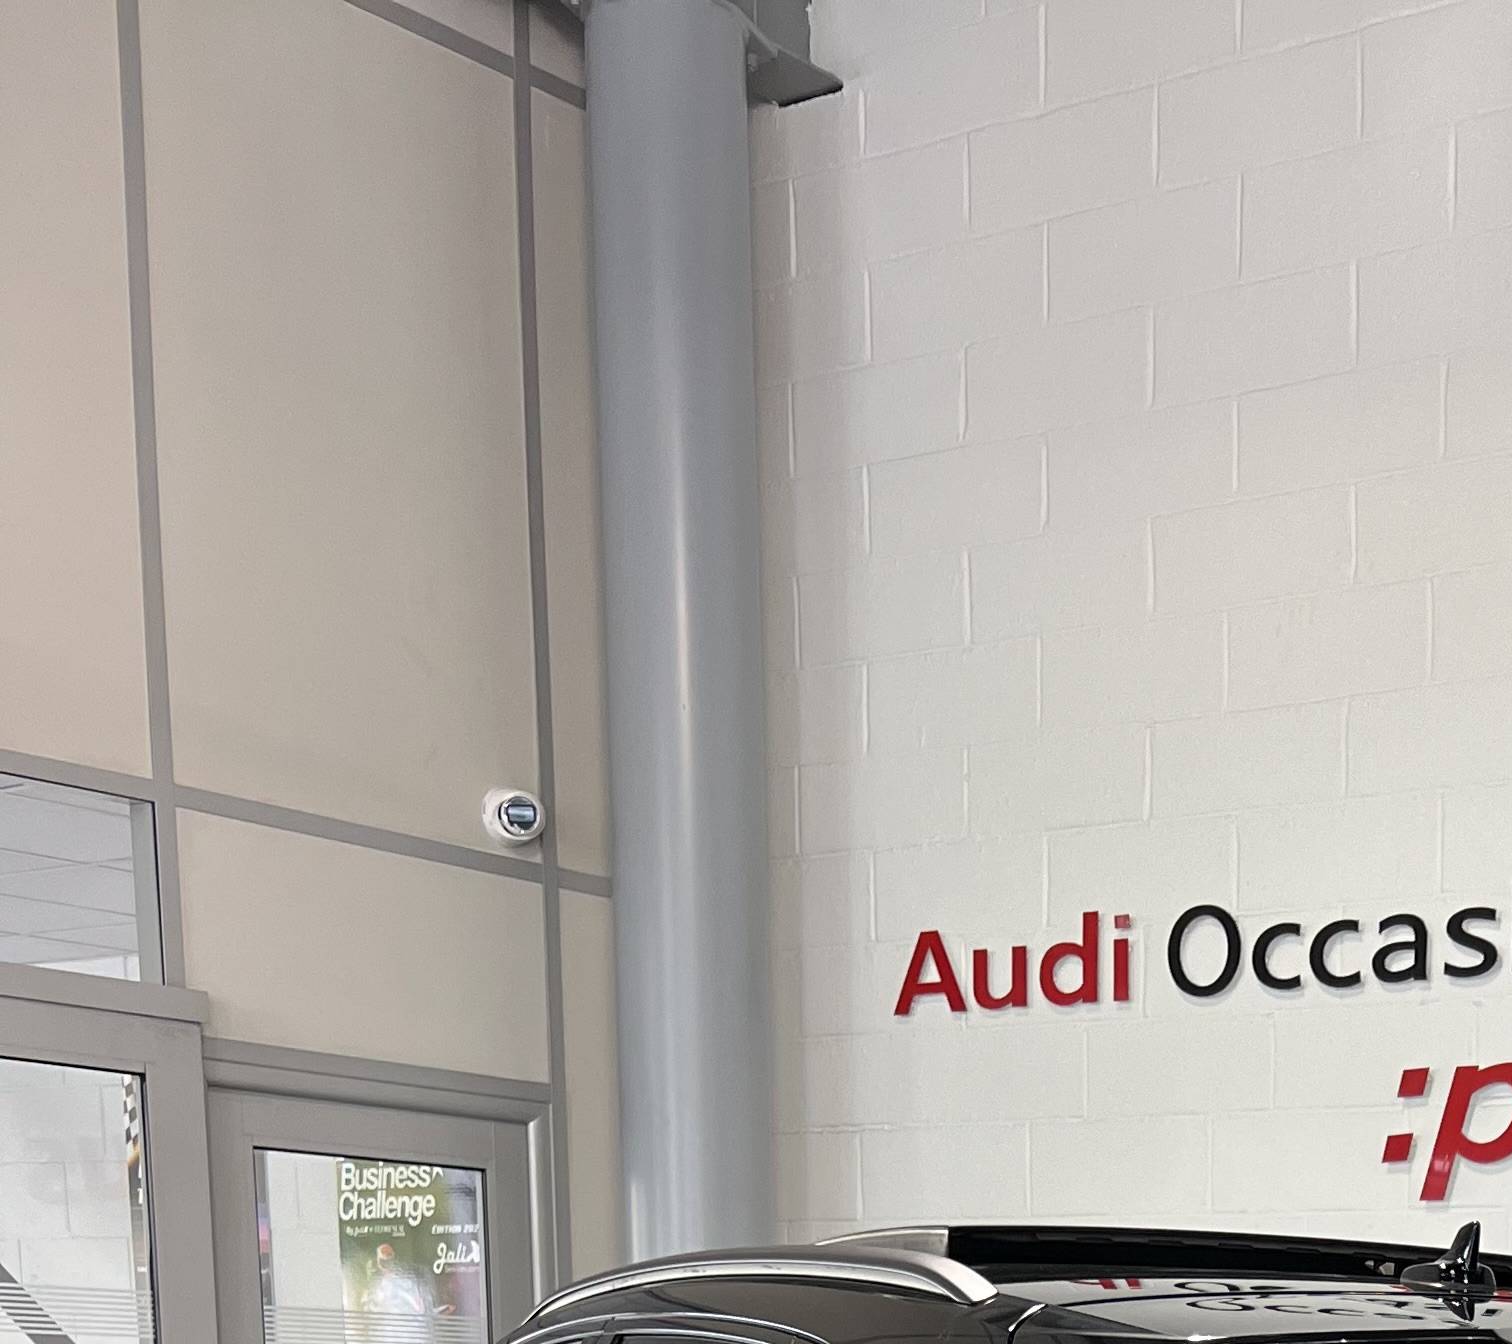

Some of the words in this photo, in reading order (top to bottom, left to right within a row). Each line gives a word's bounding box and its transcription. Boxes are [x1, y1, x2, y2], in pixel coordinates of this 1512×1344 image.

[893, 910, 1131, 1017] Audi
[341, 1161, 431, 1191] Business
[339, 1190, 436, 1226] Challenge
